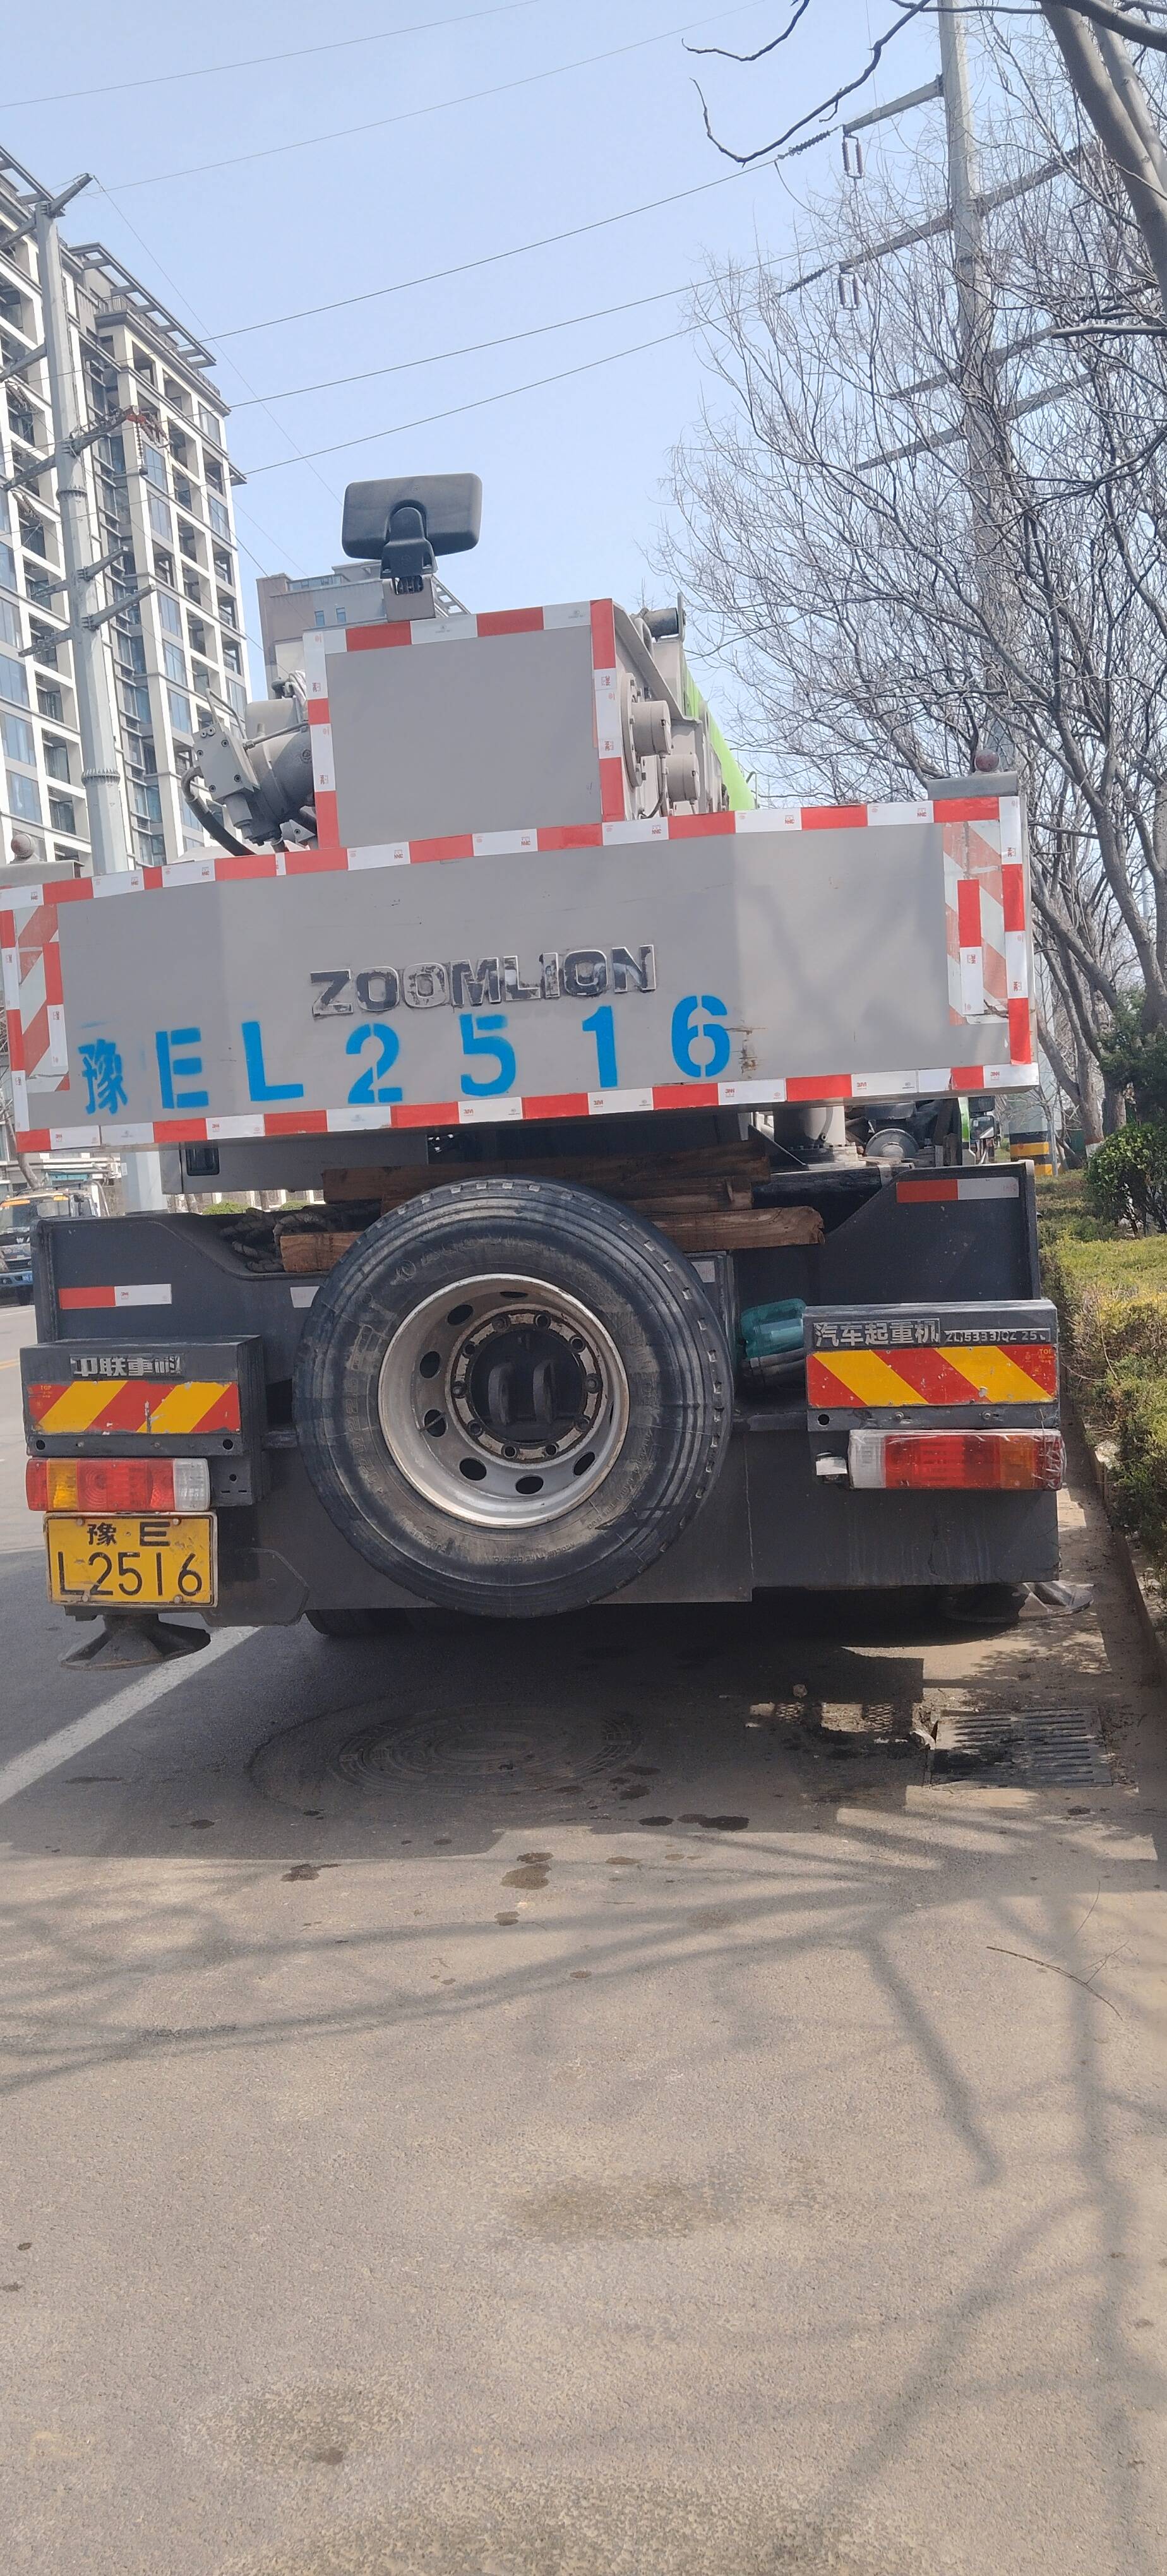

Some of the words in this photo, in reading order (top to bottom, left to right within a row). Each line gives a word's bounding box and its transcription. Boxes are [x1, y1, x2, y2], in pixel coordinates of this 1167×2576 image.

[310, 945, 655, 1017] ZOOMLION
[814, 1321, 940, 1347] 汽车起重机
[58, 1552, 202, 1596] L2516
